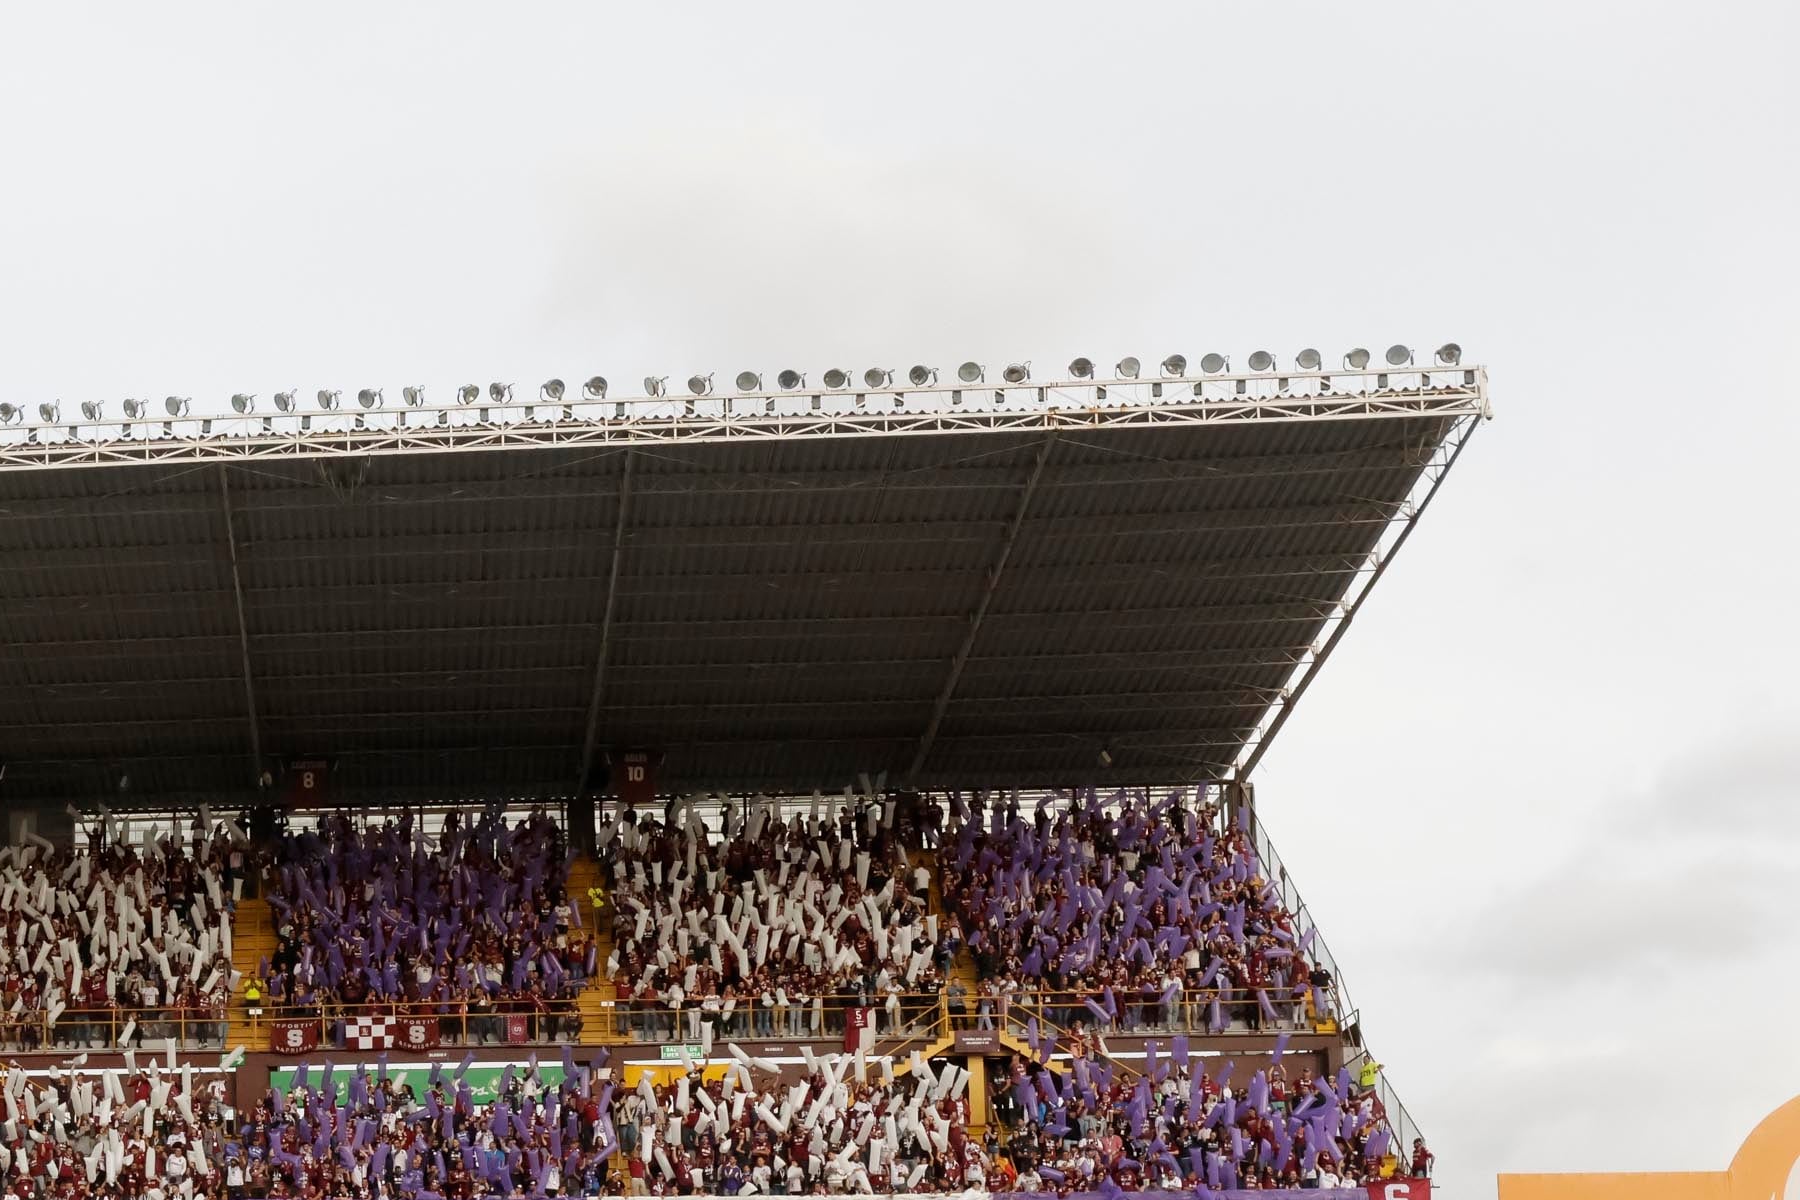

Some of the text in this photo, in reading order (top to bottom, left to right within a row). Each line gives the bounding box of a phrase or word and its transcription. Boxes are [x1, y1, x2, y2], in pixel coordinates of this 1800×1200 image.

[303, 771, 314, 788] 8
[627, 766, 644, 782] 10
[287, 1029, 303, 1047] S
[409, 1025, 425, 1043] S
